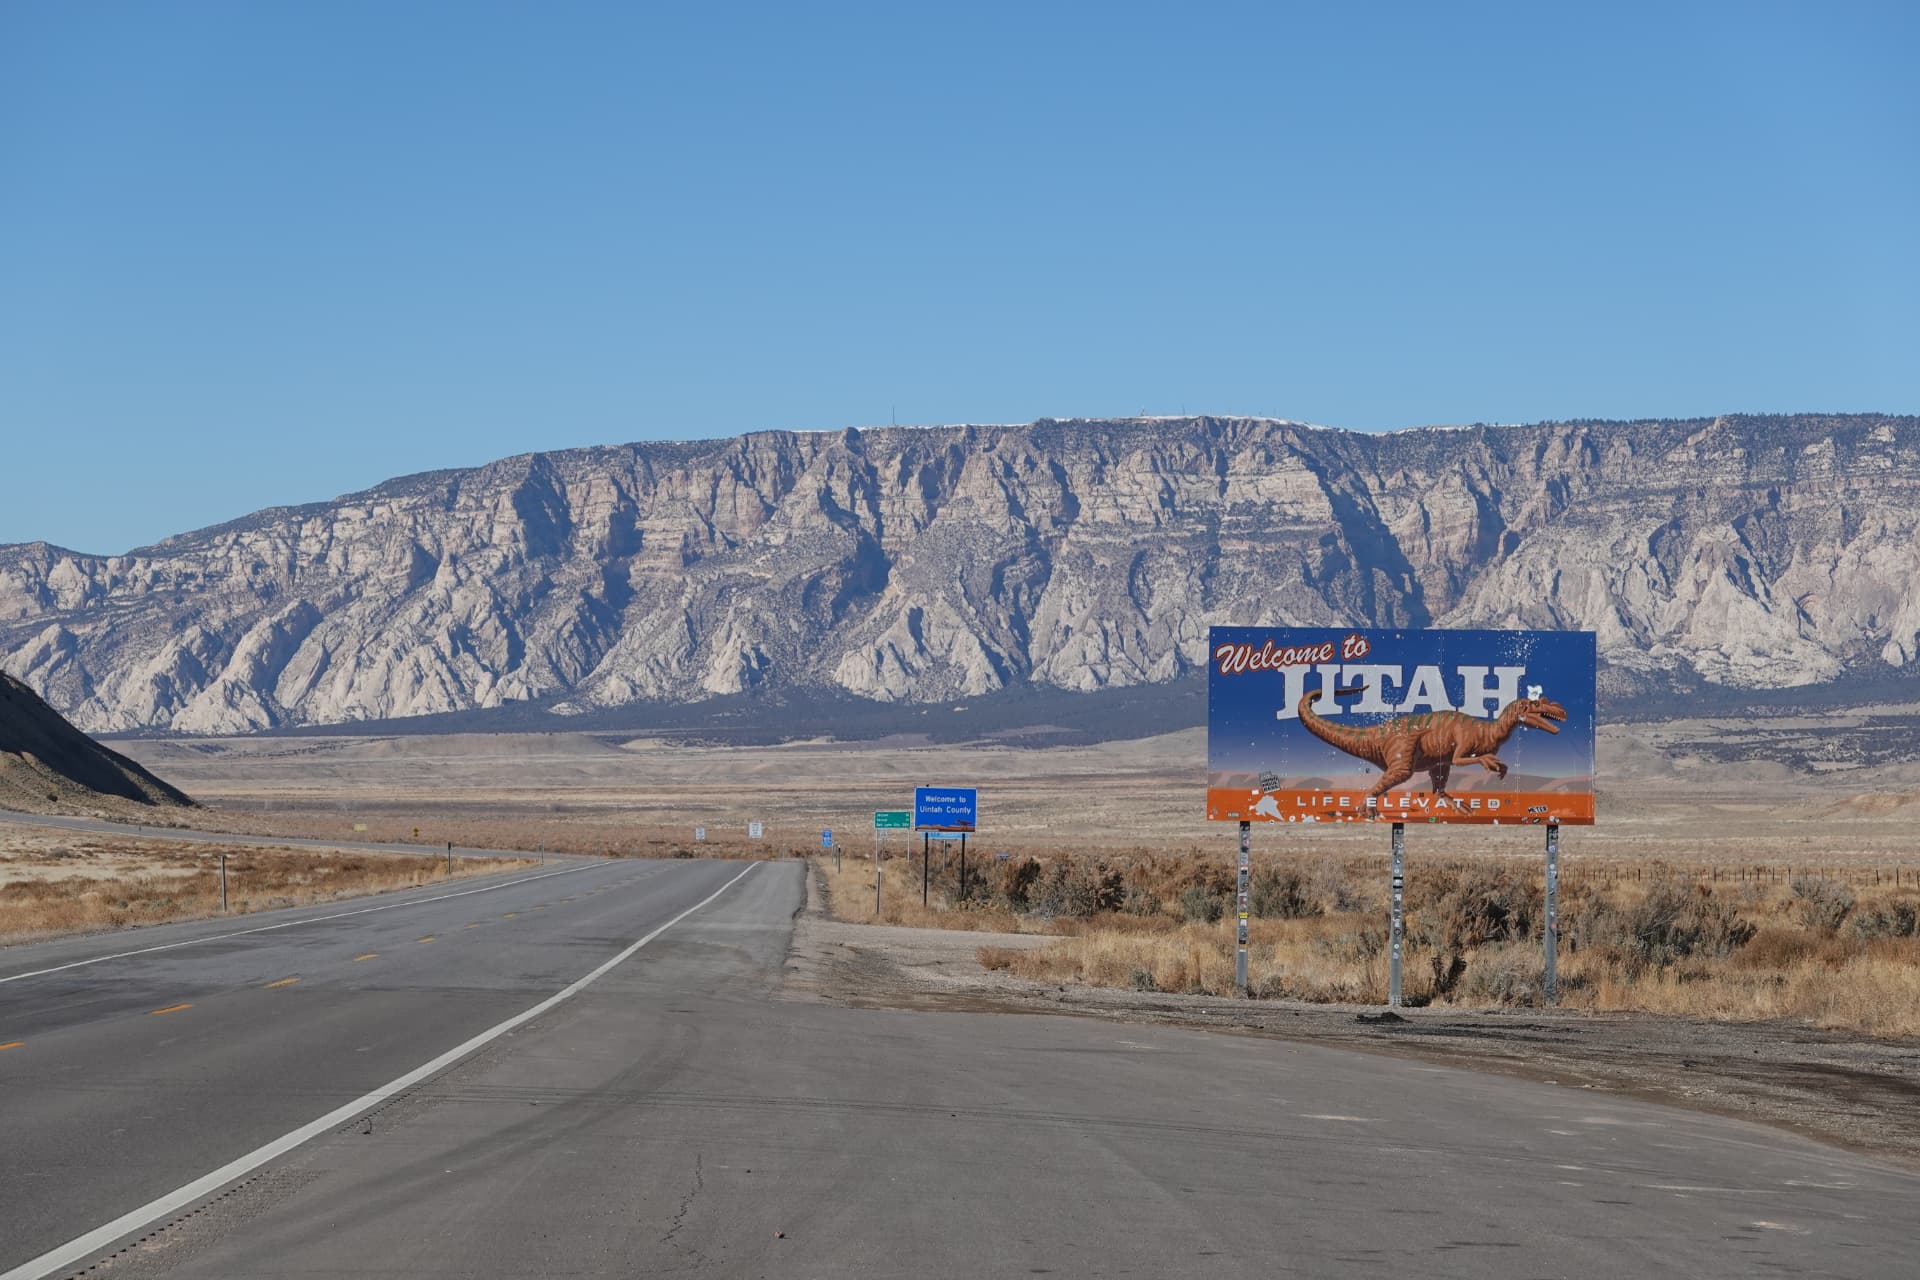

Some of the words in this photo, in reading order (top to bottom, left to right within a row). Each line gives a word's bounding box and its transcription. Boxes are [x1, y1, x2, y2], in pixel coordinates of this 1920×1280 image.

[1216, 640, 1334, 675] Welcome
[1341, 634, 1371, 660] to
[1276, 664, 1527, 720] UTAH
[925, 795, 956, 803] Welcome
[959, 795, 966, 803] to
[1296, 795, 1351, 808] LIFE
[1366, 797, 1502, 810] ELEVATED
[920, 806, 943, 814] Uintah
[946, 806, 971, 815] County
